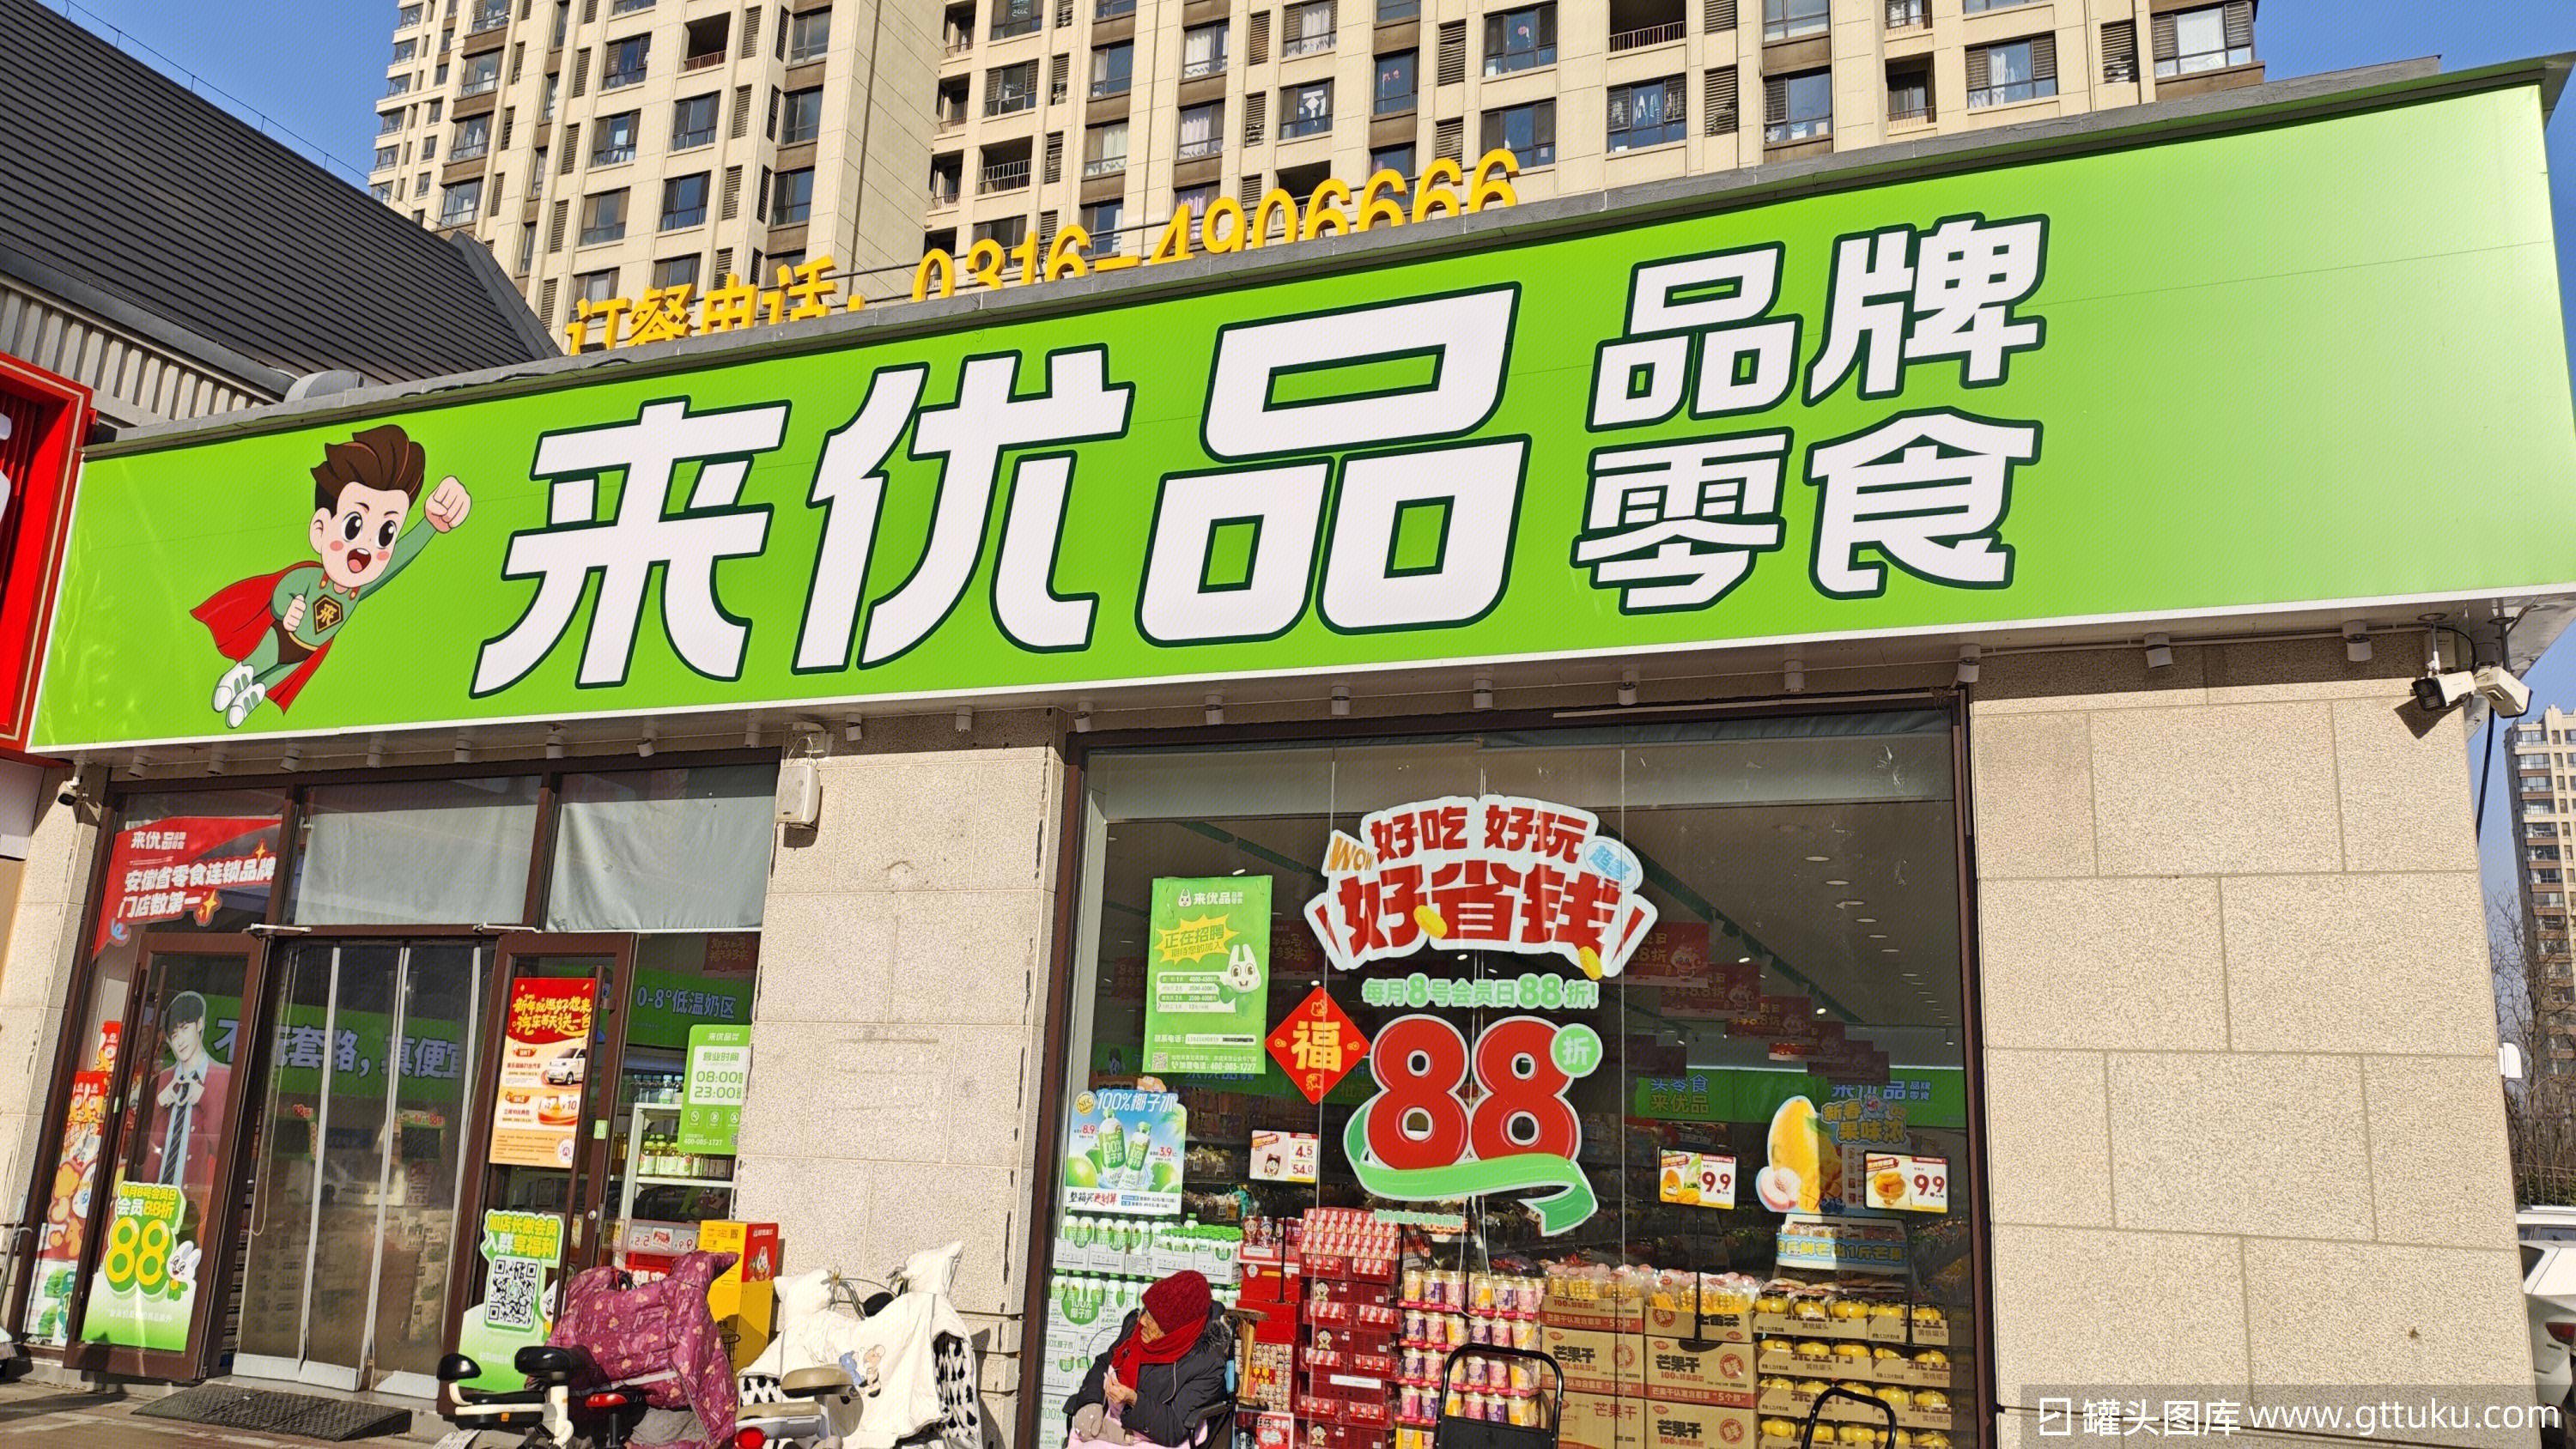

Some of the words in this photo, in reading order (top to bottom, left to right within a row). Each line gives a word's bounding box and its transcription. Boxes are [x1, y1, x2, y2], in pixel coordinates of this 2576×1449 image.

[912, 149, 1519, 301] 0316-4906666
[1586, 213, 2050, 432] 品牌
[470, 285, 1529, 696] 来优品
[1570, 406, 2044, 615] 零食
[317, 603, 337, 627] 来
[131, 831, 173, 850] 来优品
[1371, 807, 1467, 864] 好吃
[1485, 804, 1588, 864] 好玩
[1327, 835, 1375, 871] WOW
[125, 857, 276, 893] 安徽省零食连锁品牌
[118, 892, 202, 919] 门店数第一
[1193, 893, 1230, 905] 来优品
[1338, 860, 1622, 960] 好省钱
[1165, 925, 1224, 949] 正在招聘
[1362, 973, 1599, 1008] 每月8号会员日88折!
[702, 1052, 739, 1062] 营业时间
[1291, 1022, 1342, 1072] 福
[696, 1070, 738, 1082] 08:00
[694, 1086, 736, 1098] 23:00
[1097, 1091, 1176, 1113] 100%椰子水
[1368, 1018, 1582, 1170] 88
[1562, 1036, 1590, 1065] 折
[1650, 1093, 1709, 1113] 来优品
[1839, 1119, 1905, 1143] 果味浓
[1295, 1145, 1313, 1157] 4.5
[120, 1185, 177, 1201] 每月8号会员日
[1702, 1172, 1731, 1193] 9.9
[1914, 1174, 1945, 1197] 9.9
[488, 1212, 561, 1236] 加店长做会员
[106, 1217, 169, 1286] 88
[484, 1233, 556, 1258] 入群享福利
[1553, 1344, 1595, 1364] 芒果干
[1656, 1354, 1700, 1373] 芒果干
[1594, 1401, 1637, 1421] 芒果干
[1657, 1419, 1702, 1440] 芒果干
